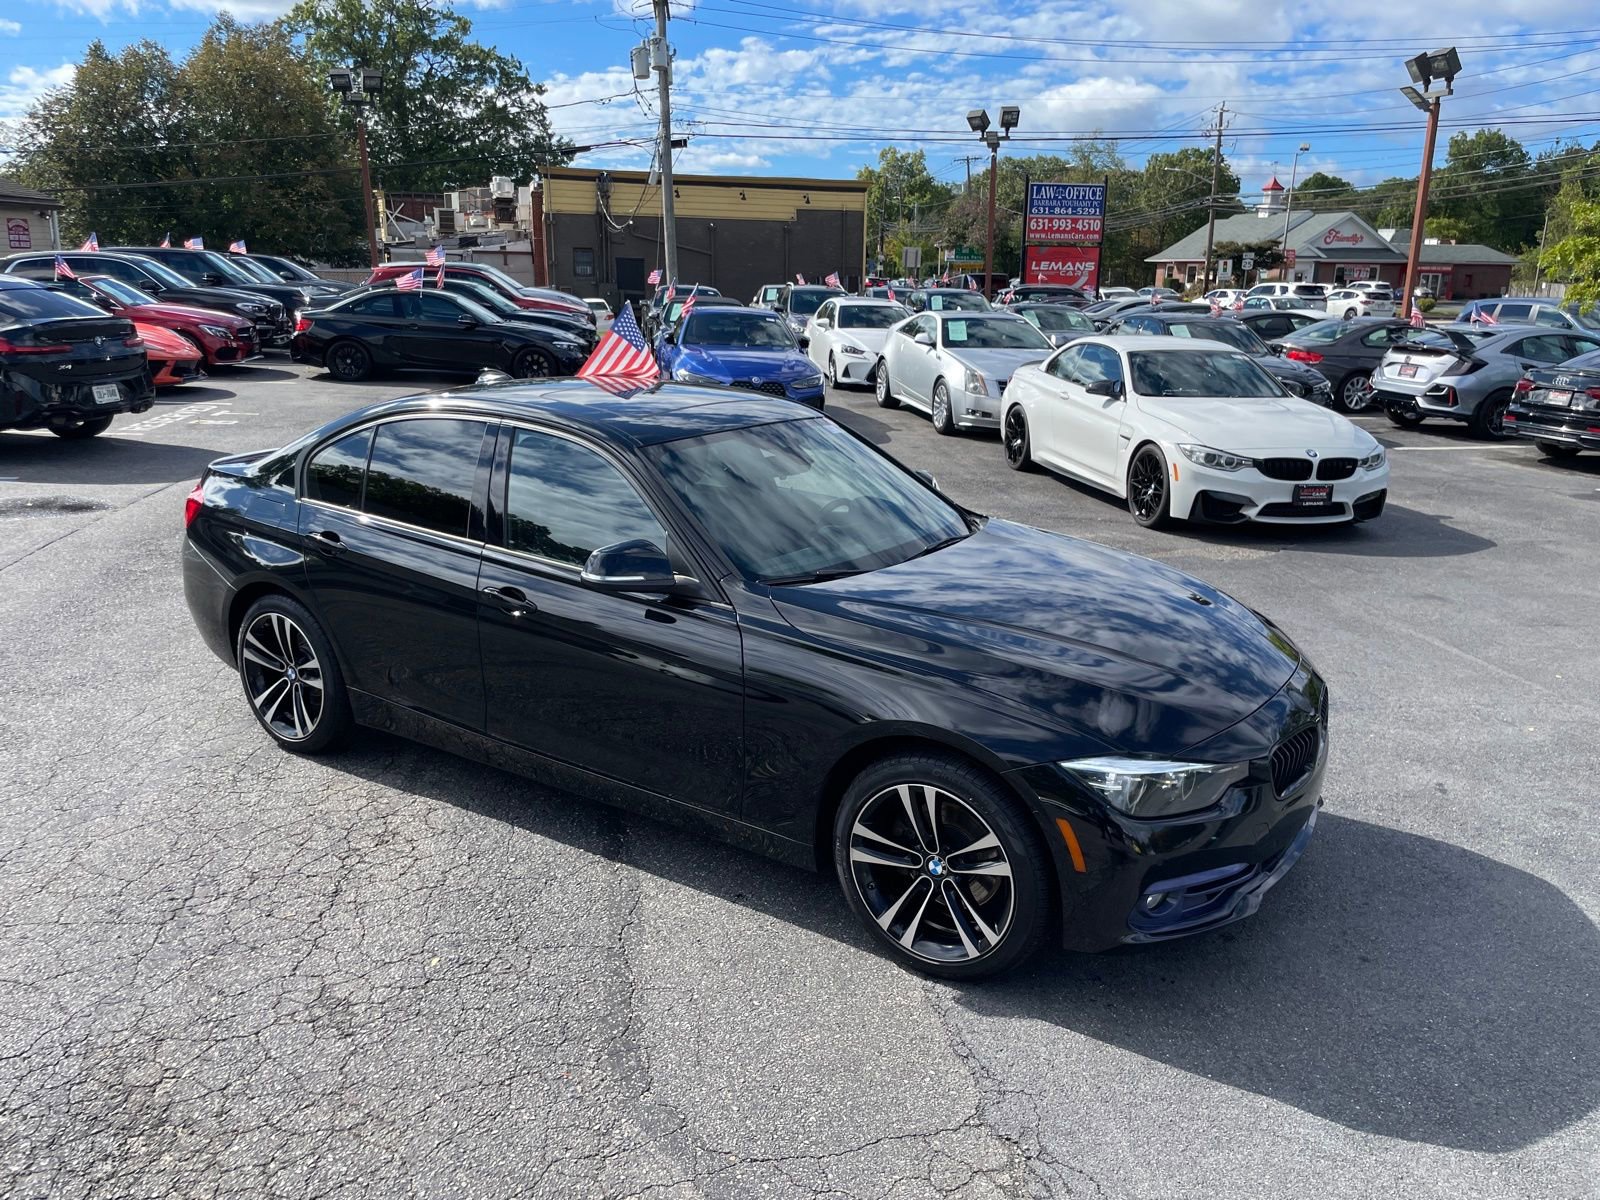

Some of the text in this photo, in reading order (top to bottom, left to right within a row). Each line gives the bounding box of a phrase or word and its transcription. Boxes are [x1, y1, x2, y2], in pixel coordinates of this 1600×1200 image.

[1033, 186, 1103, 200] LAW OFFICE
[1033, 199, 1061, 207] BARBARA
[1031, 207, 1100, 215] 631-864-5291
[1030, 218, 1101, 231] 631-993-4510
[1031, 261, 1095, 270] LEMANS
